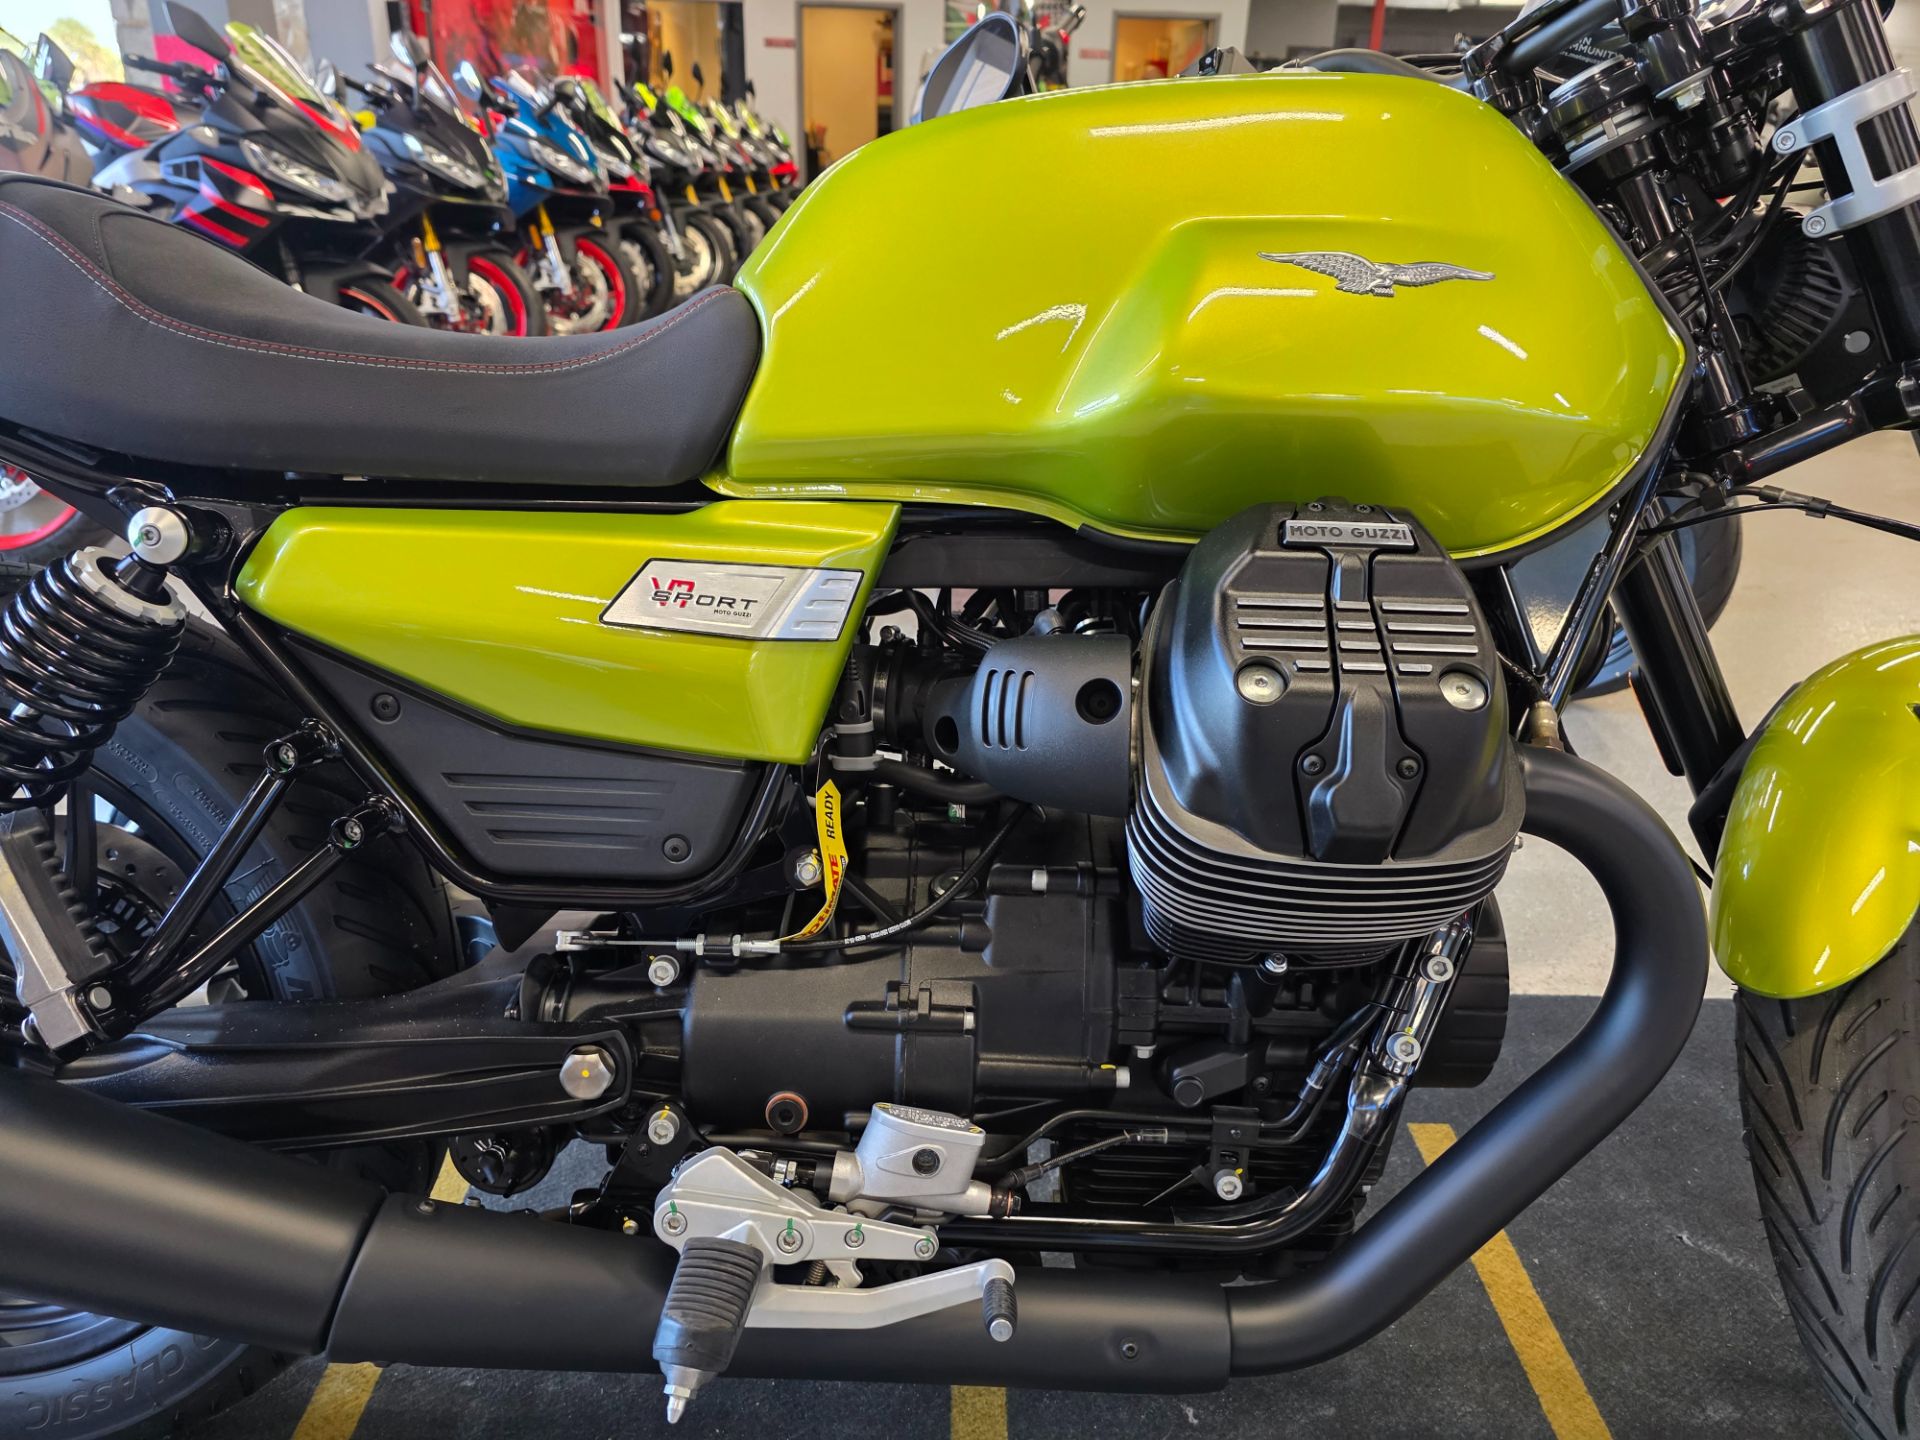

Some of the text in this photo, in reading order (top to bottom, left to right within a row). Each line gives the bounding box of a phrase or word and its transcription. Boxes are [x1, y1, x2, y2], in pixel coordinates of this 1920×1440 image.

[1289, 525, 1408, 540] MOTO GUZZI
[651, 590, 758, 610] SPORT
[825, 791, 835, 839] READY
[25, 1343, 187, 1430] CLASSIC
